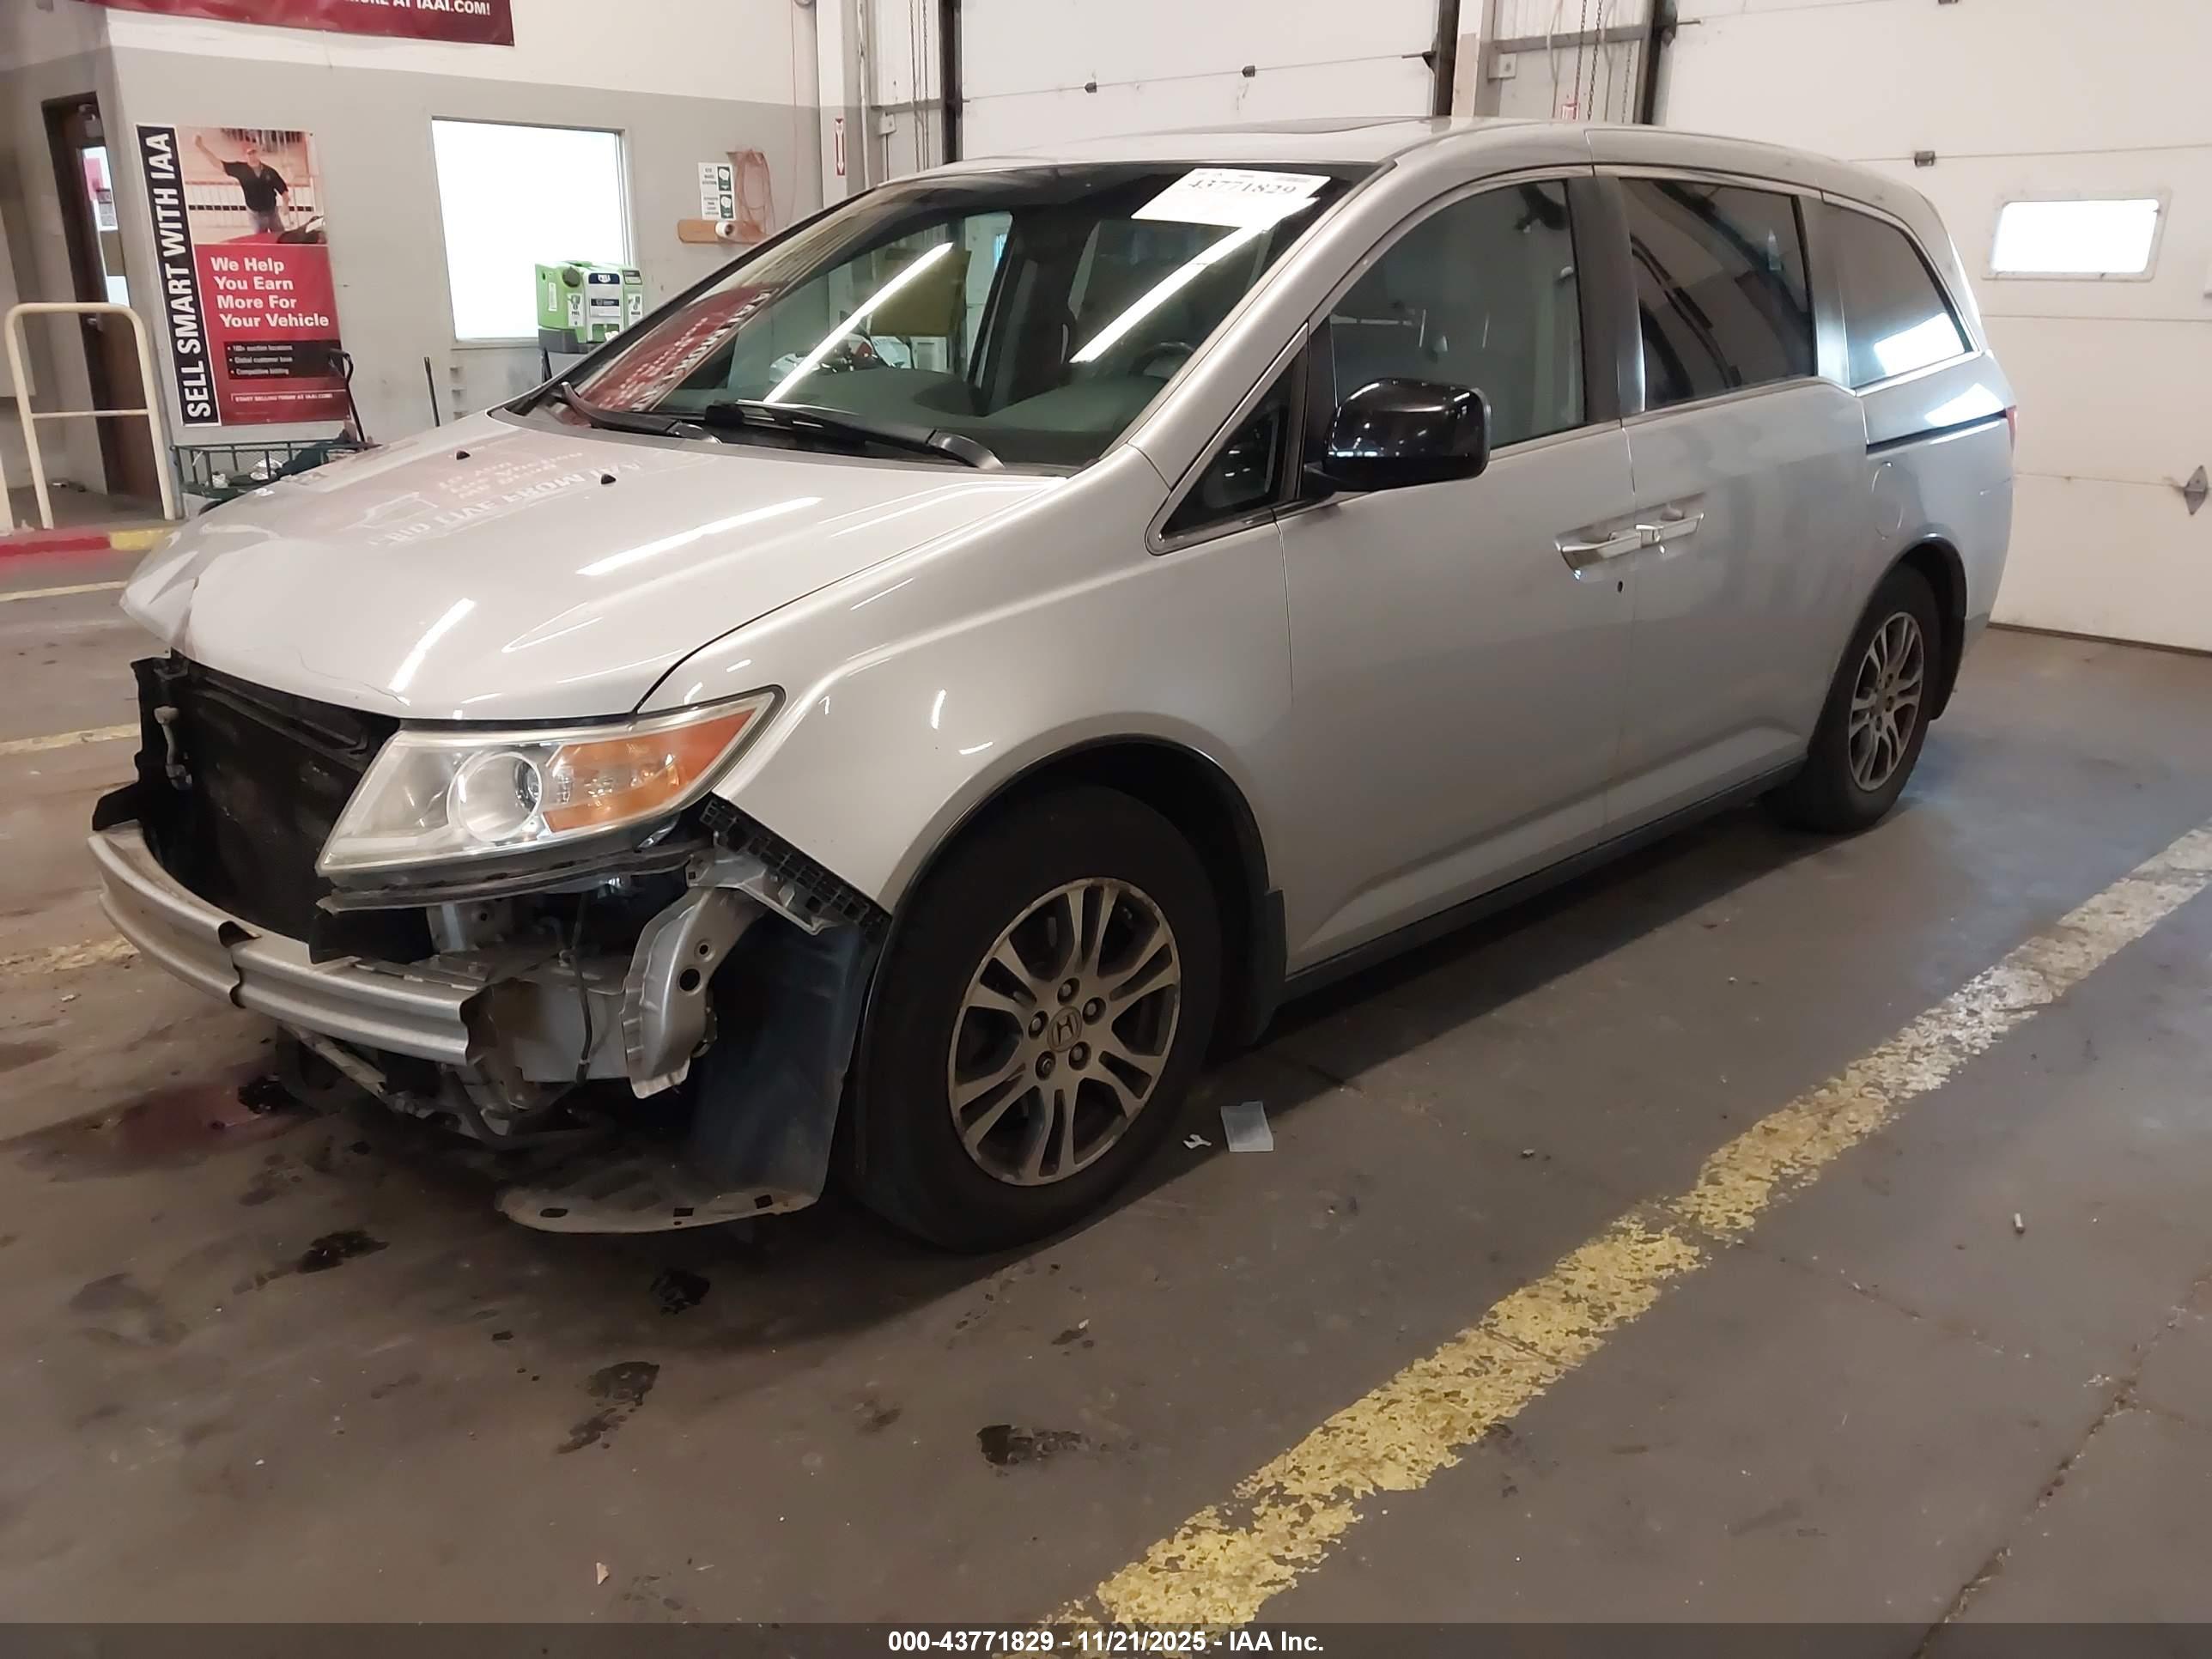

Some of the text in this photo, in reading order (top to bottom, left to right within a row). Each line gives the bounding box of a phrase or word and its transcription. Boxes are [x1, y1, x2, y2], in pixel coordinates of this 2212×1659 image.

[416, 0, 490, 15] IAAI.COM!
[210, 257, 285, 275] We Help
[144, 133, 211, 418] SELL SMART WITH IAA
[213, 276, 295, 290] You Earn
[216, 295, 297, 309] More For
[220, 313, 330, 327] Your Vehicle
